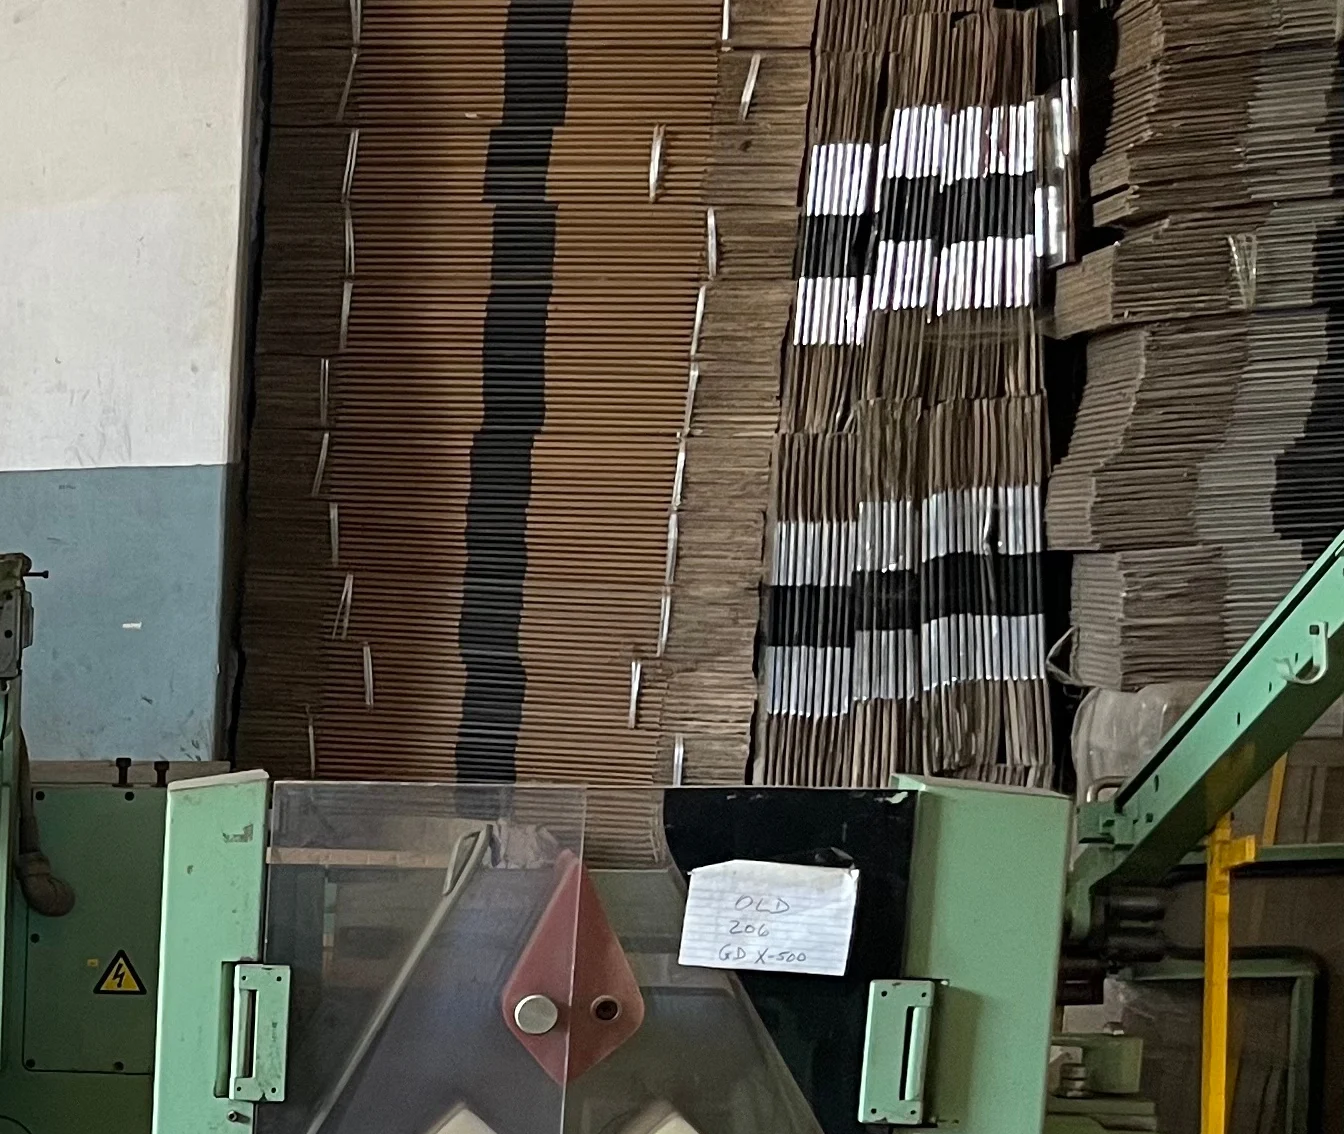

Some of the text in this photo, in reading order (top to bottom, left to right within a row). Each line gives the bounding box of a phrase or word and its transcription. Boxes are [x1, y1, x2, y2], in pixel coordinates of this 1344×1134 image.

[734, 895, 790, 914] OLD
[728, 920, 770, 937] 206
[718, 944, 807, 964] GD X-500
